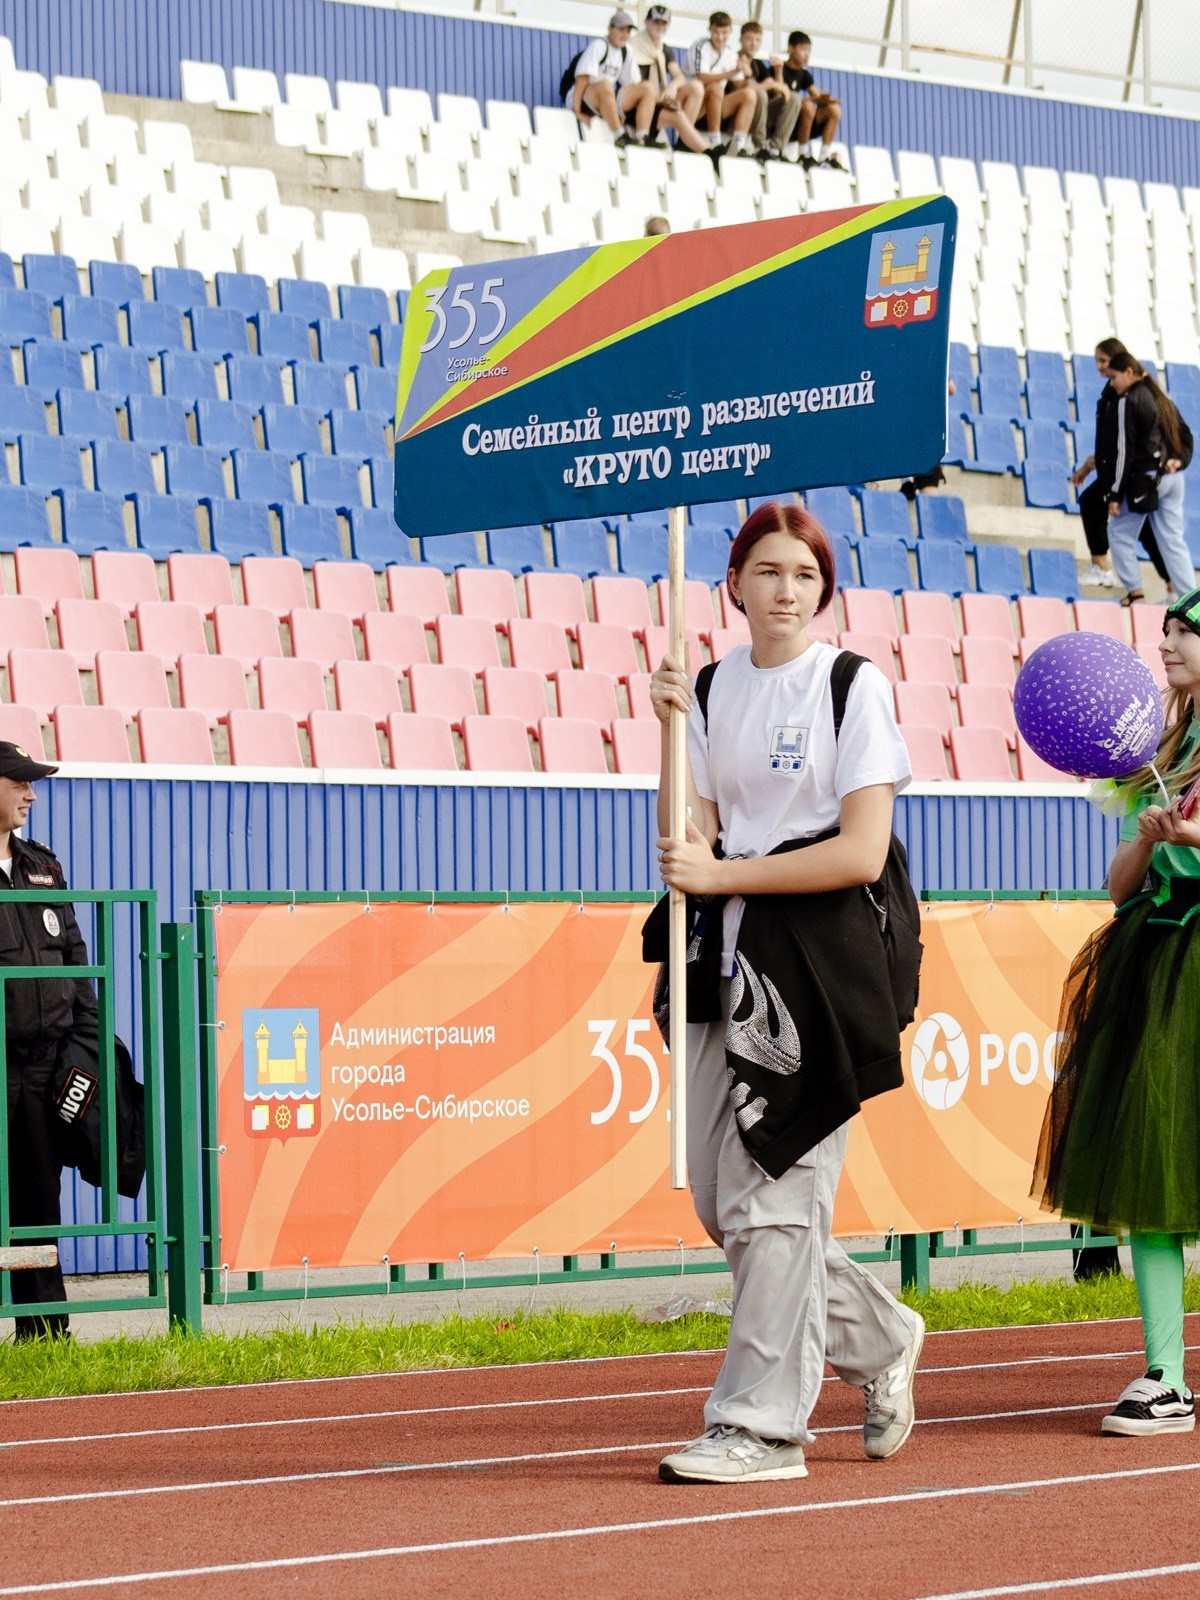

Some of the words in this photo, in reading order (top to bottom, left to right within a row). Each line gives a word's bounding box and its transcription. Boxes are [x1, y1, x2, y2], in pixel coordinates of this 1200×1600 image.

[420, 278, 507, 354] 355
[446, 366, 508, 382] Сибирское
[447, 355, 491, 370] Усолье-
[462, 407, 602, 456] Семейный
[611, 405, 691, 442] центр
[700, 370, 876, 436] развлечений
[563, 445, 672, 488] «КРУТО
[681, 442, 771, 478] центр»
[330, 1021, 496, 1051] Администрация
[331, 1063, 406, 1089] города
[587, 1018, 671, 1125] 35
[331, 1094, 530, 1124] Усолье-Сибирское
